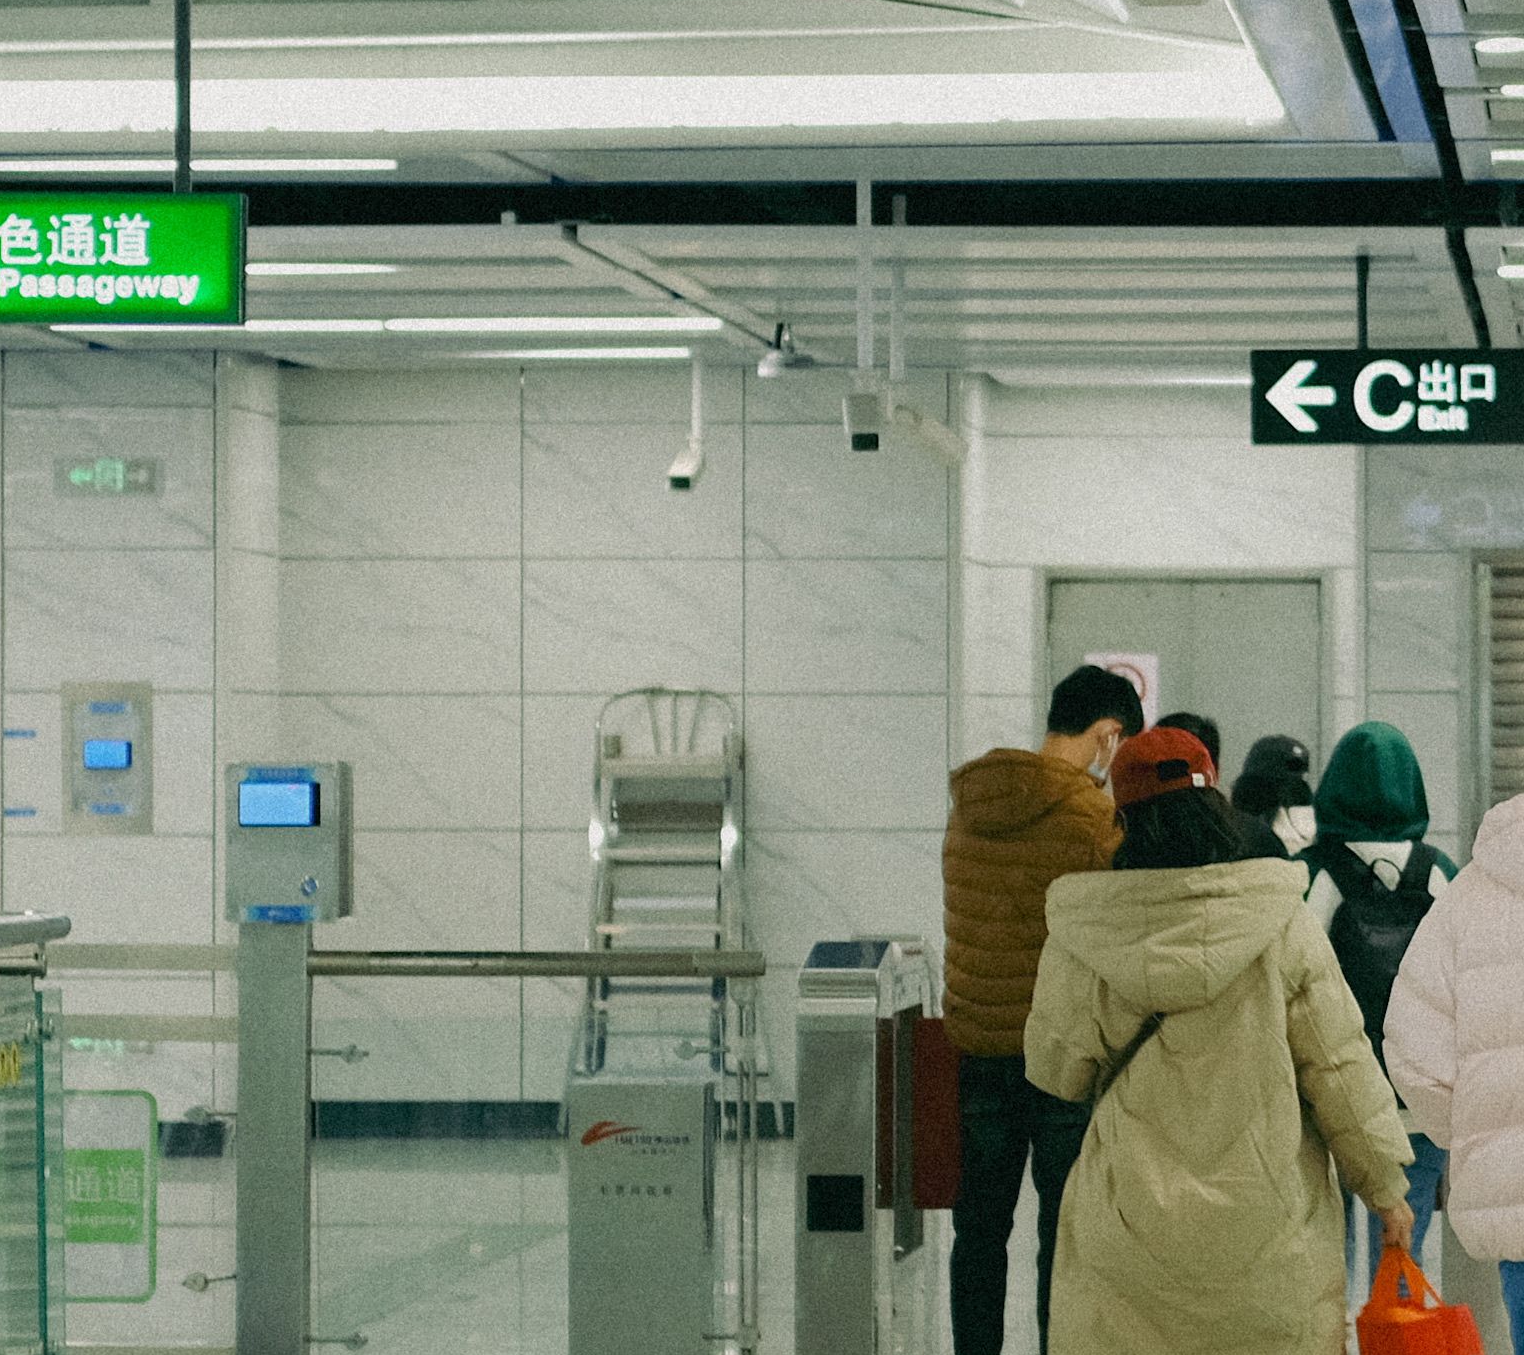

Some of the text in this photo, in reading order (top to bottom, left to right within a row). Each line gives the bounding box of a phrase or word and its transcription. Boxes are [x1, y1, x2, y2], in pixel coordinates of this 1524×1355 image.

[1352, 358, 1497, 432] C 出口
[1416, 404, 1469, 432] Exit
